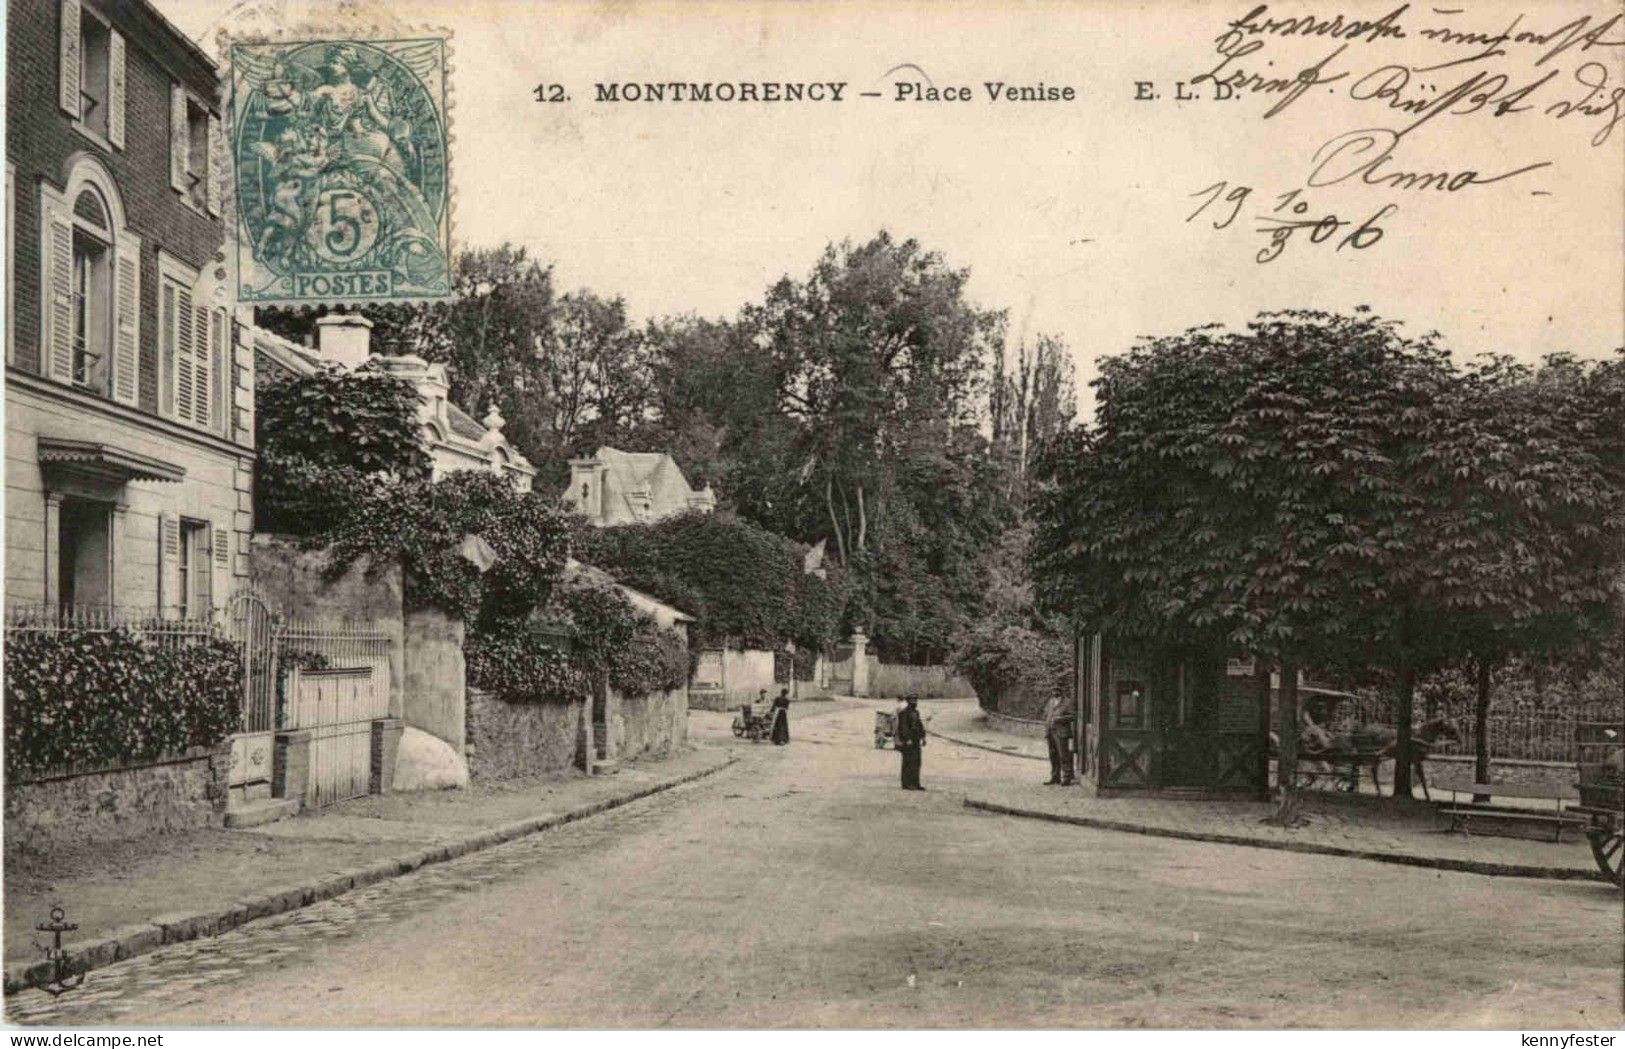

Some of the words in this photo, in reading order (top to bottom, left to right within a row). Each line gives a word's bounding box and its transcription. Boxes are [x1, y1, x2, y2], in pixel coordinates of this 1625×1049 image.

[533, 84, 571, 102] 12.
[594, 83, 847, 102] MONTMORENCY
[894, 81, 973, 102] Place
[984, 82, 1076, 102] Venise
[1134, 81, 1161, 101] E.
[297, 273, 390, 298] POSTES
